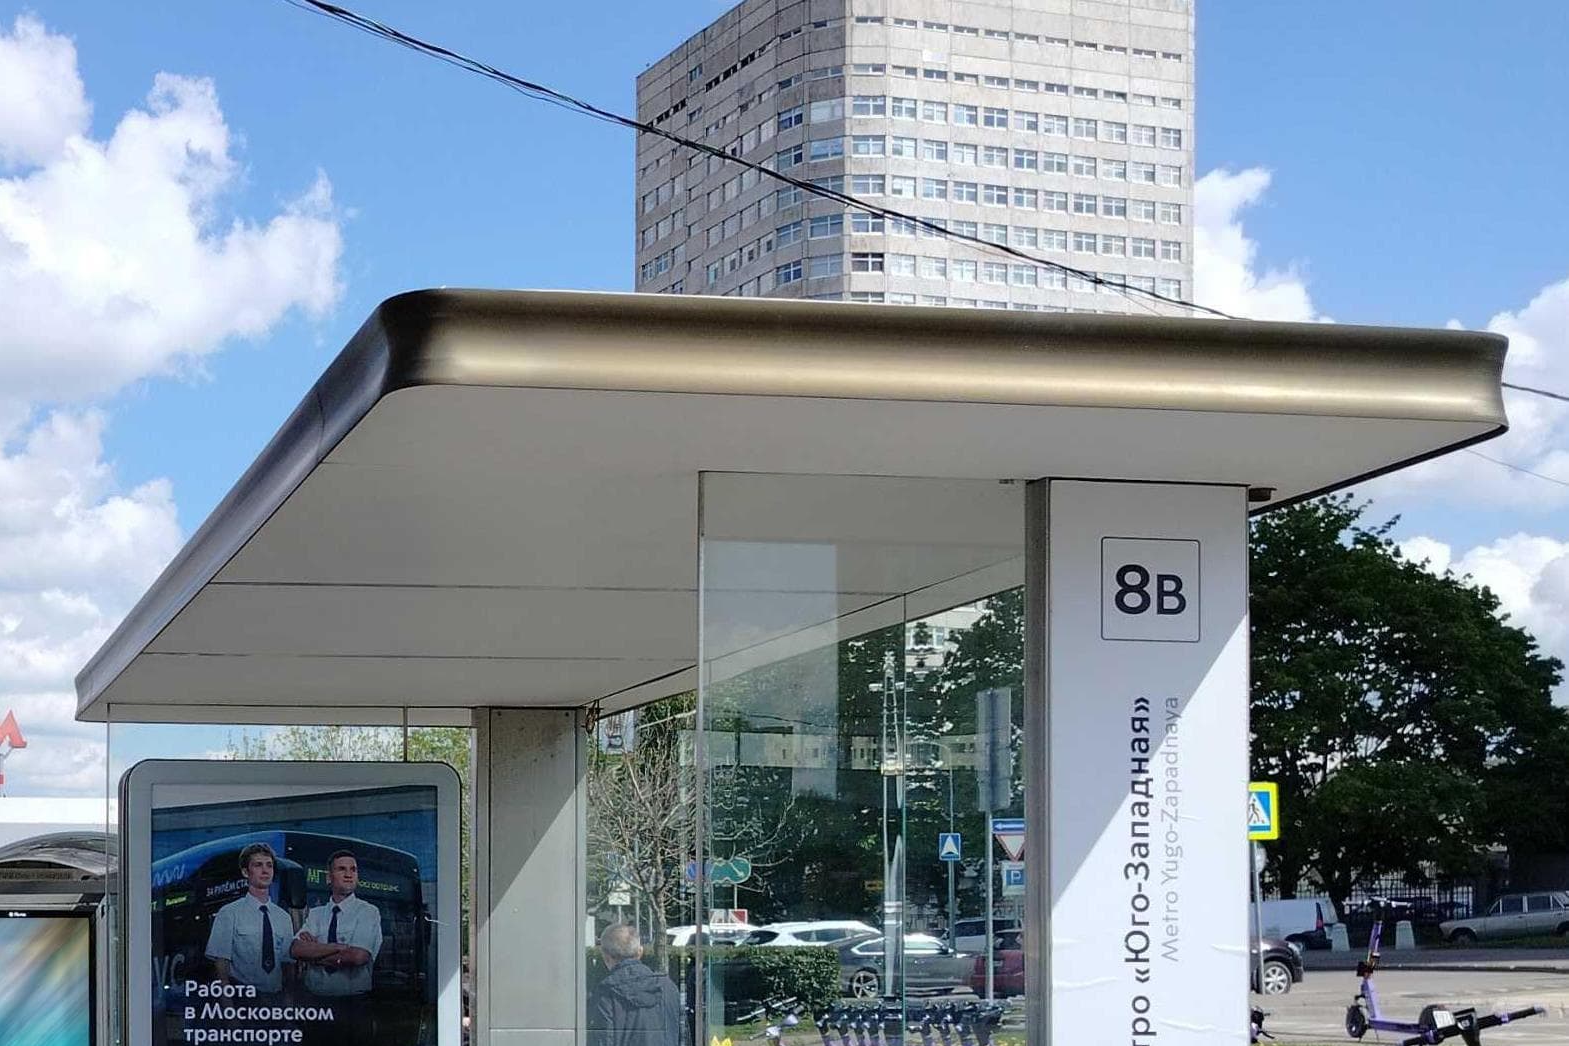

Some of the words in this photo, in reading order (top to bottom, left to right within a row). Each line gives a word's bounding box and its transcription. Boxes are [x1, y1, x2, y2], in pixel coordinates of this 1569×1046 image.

[1160, 697, 1183, 885] Yugo-Zapadnaya
[1124, 697, 1154, 983] «Юго-Западная»
[1161, 890, 1179, 962] Metro
[185, 980, 256, 998] Работа
[185, 1007, 196, 1020] в
[201, 1002, 334, 1021] Московском
[184, 1028, 303, 1046] транспорте
